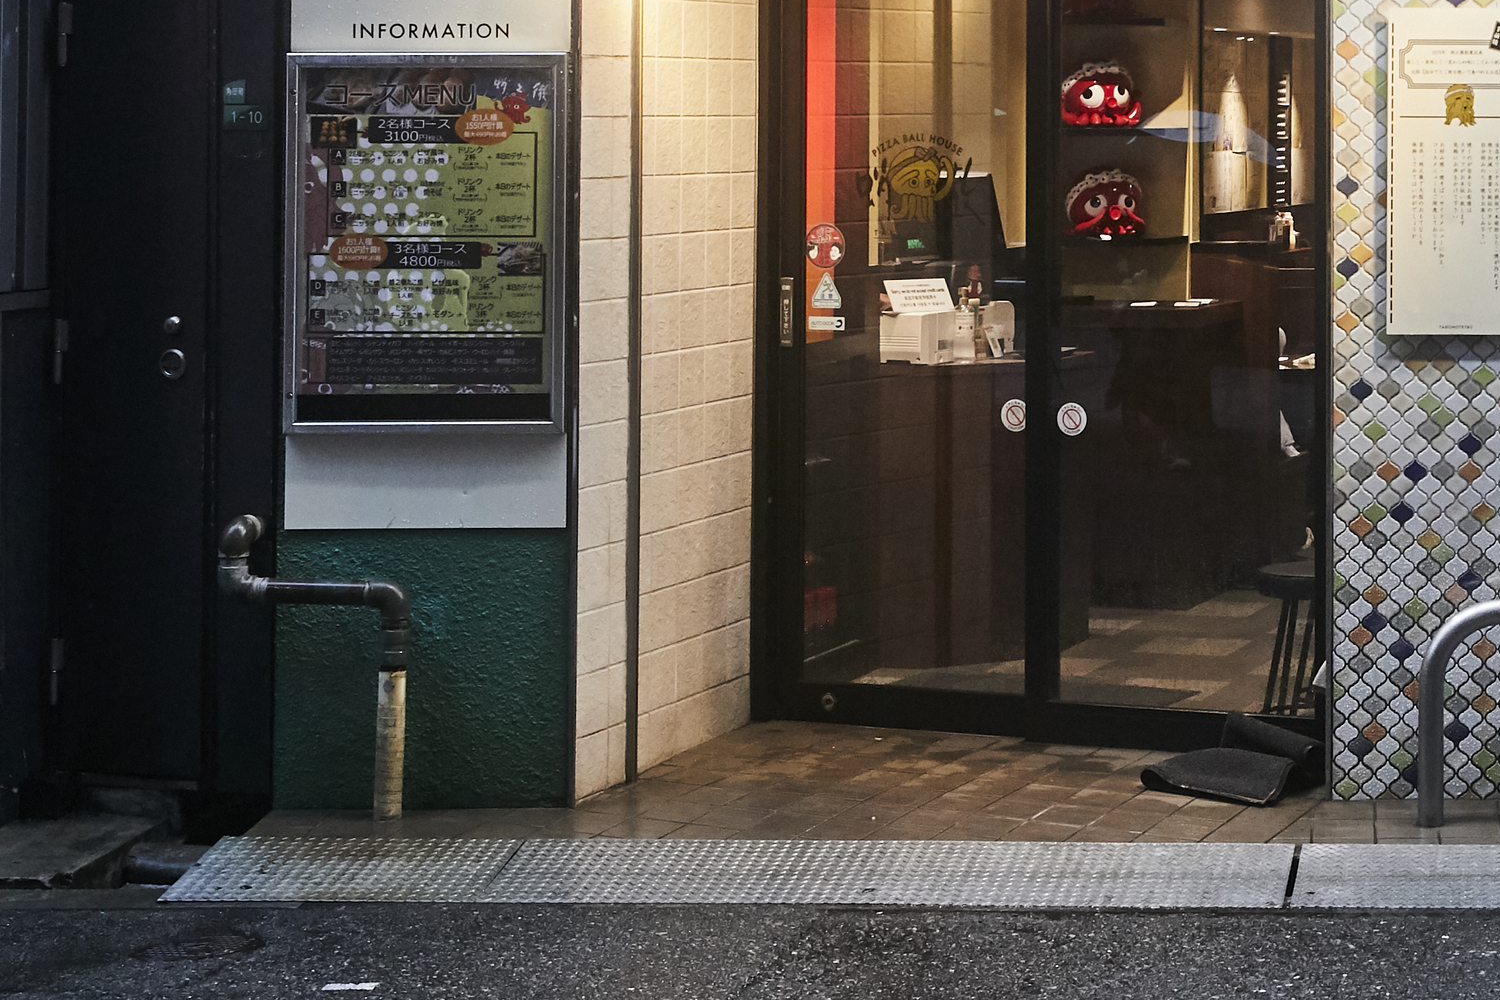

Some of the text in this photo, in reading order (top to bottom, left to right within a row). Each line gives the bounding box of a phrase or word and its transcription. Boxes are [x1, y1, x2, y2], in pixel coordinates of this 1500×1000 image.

[352, 23, 510, 39] INFORMATION
[325, 83, 477, 107] コースMENU
[231, 110, 263, 124] 1-10
[378, 119, 451, 129] 2名様コース
[458, 146, 484, 154] ドリンク
[871, 133, 964, 157] PIZZA BALL HOUSE
[335, 182, 342, 190] B
[458, 208, 483, 216] ドリンク
[335, 214, 342, 222] C
[394, 244, 467, 254] 3名様コース
[315, 282, 321, 290] D
